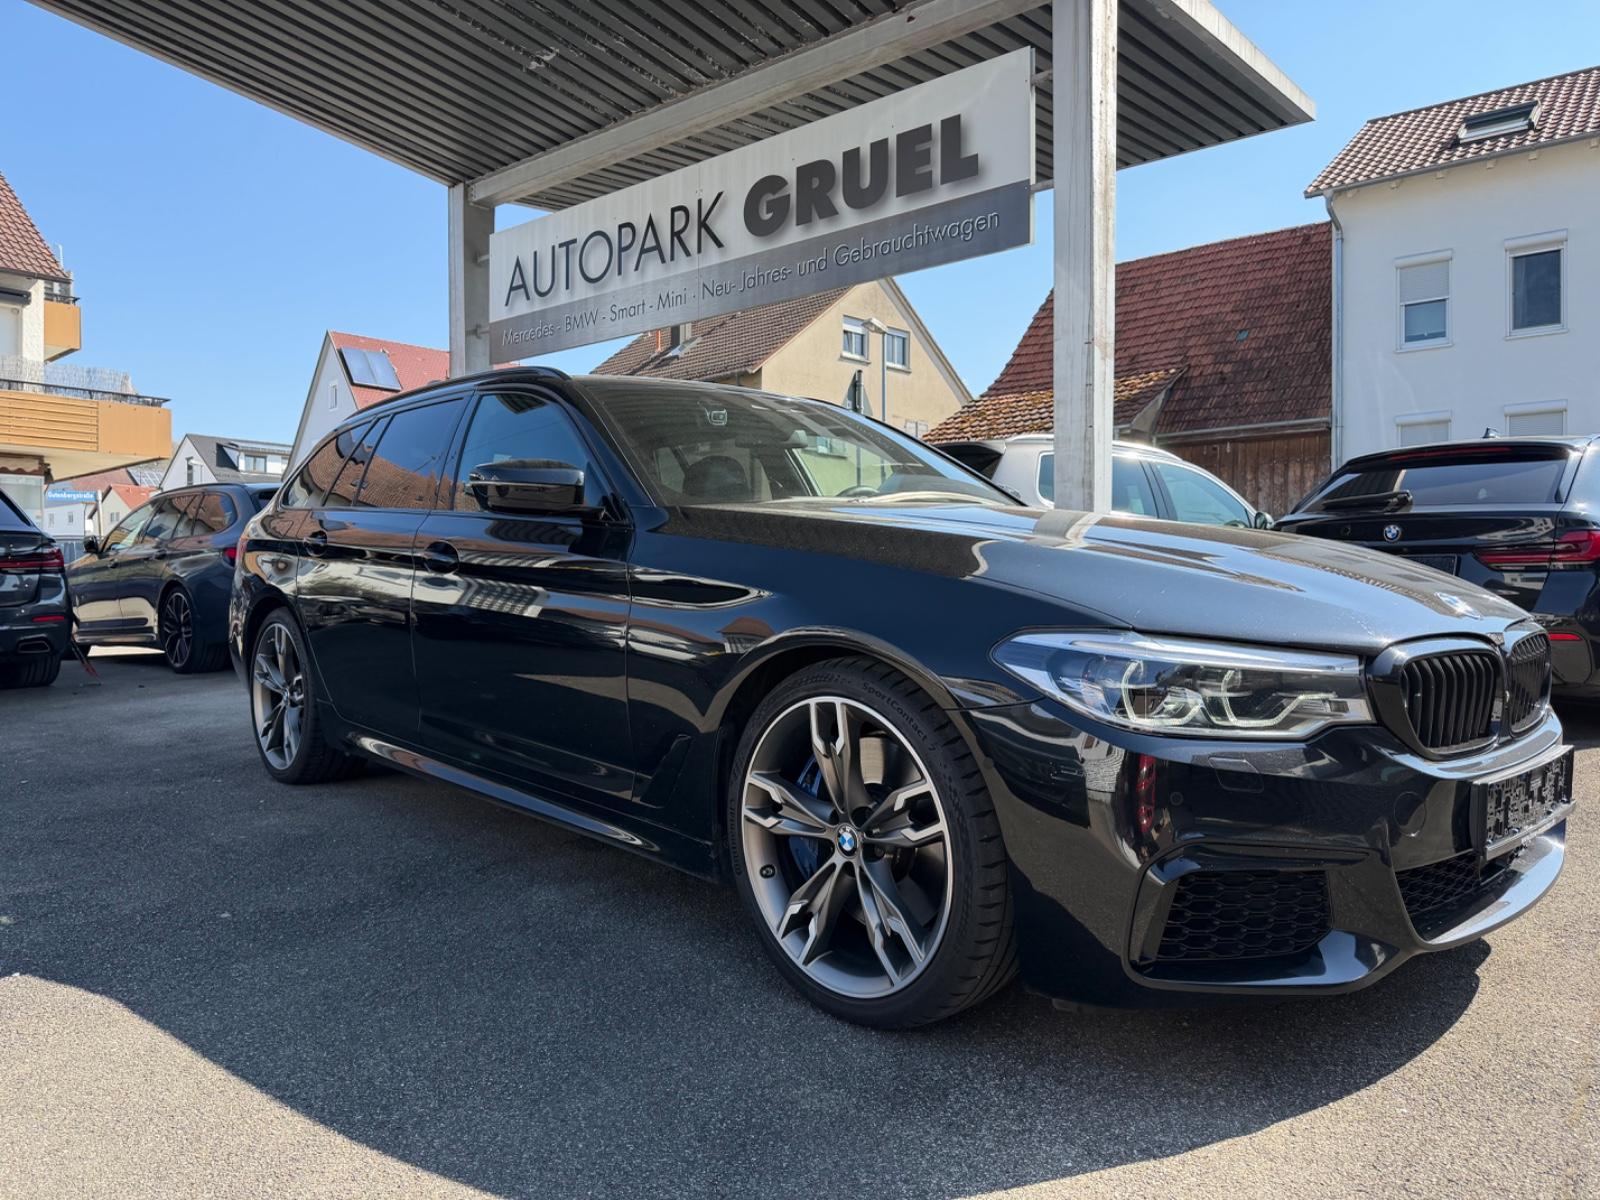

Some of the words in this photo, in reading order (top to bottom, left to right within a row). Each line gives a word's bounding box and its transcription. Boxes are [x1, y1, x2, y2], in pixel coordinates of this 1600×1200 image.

[504, 191, 724, 306] AUTOPARK
[743, 114, 979, 237] GRUEL
[502, 320, 555, 346] Mercedes
[565, 307, 599, 333] BMW
[610, 299, 646, 322] Smart
[657, 287, 687, 311] Mini
[798, 247, 828, 276] und
[833, 211, 1000, 267] Gebrauchtwagen
[862, 682, 927, 742] SportContact
